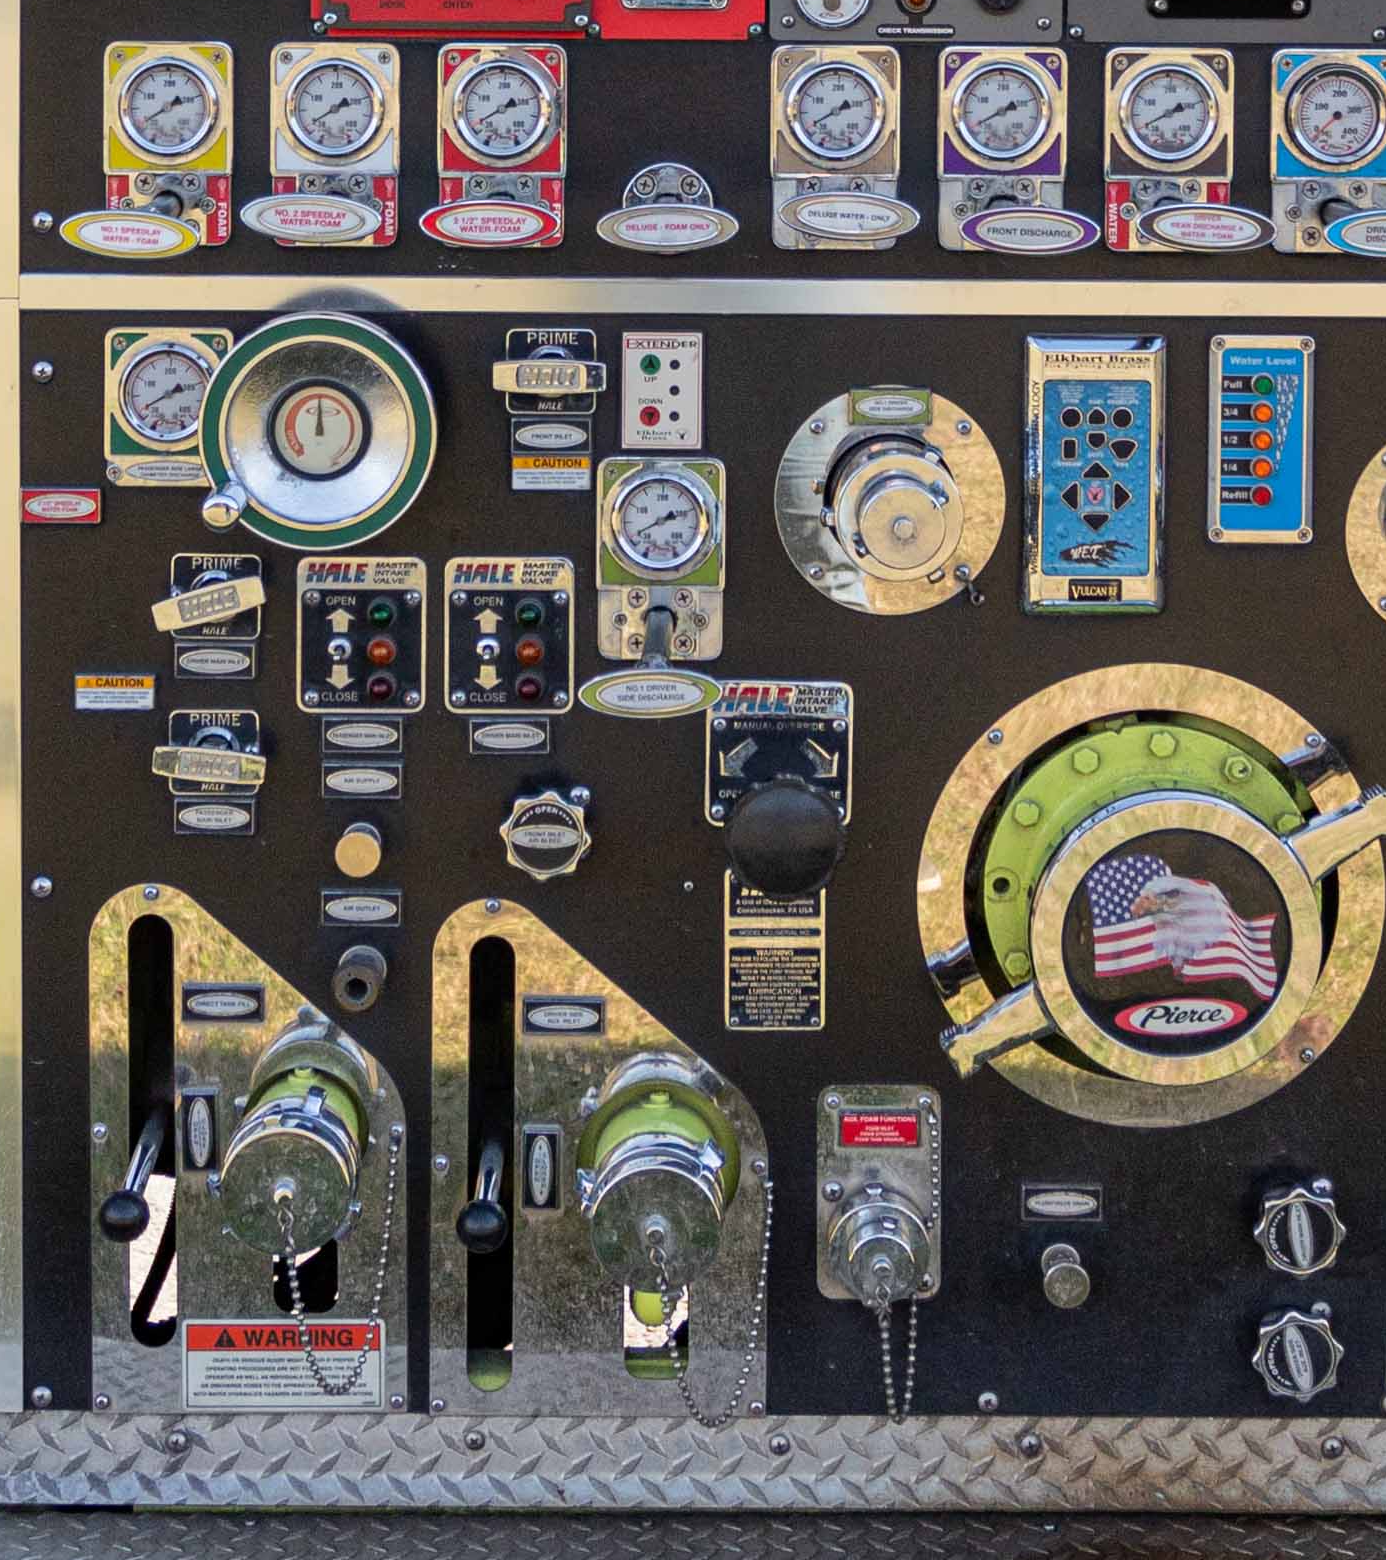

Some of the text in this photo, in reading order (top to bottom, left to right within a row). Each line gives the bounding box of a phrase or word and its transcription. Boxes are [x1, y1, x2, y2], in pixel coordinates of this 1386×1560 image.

[1332, 90, 1347, 98] 200
[217, 202, 228, 237] FOAM
[385, 201, 394, 236] FOAM
[1109, 202, 1118, 243] WATER
[987, 227, 1074, 238] FRONT DISCHARGE
[527, 332, 578, 345] PRIME
[626, 339, 697, 349] EXTENDER
[1045, 355, 1151, 364] Elkhart Brass
[1230, 356, 1296, 366] Water Level
[164, 367, 177, 375] 200
[1223, 380, 1242, 389] Full
[538, 401, 563, 410] HALE
[1223, 408, 1239, 417] 3/4
[1222, 435, 1238, 445] 1/2
[533, 458, 582, 468] CAUTION
[1222, 463, 1238, 472] 1/4
[1221, 491, 1248, 500] Refill
[191, 556, 242, 569] PRIME
[191, 557, 243, 570] PRIME
[306, 563, 368, 584] HALE
[453, 563, 515, 584] HALE
[326, 596, 356, 606] OPEN
[473, 596, 503, 606] OPEN
[202, 626, 228, 635] HALE
[95, 678, 144, 688] CAUTION
[797, 688, 842, 696] MASTER
[322, 692, 358, 703] CLOSE
[469, 693, 506, 703] CLOSE
[617, 694, 685, 702] SIDE DISCHARGE
[795, 697, 835, 705] INTAKE
[793, 706, 827, 714] VALVE
[190, 714, 241, 727] PRIME
[201, 783, 226, 792] HALE
[535, 805, 558, 815] OPEN
[1140, 1004, 1225, 1029] Pierce
[1270, 1227, 1278, 1251] OPEN
